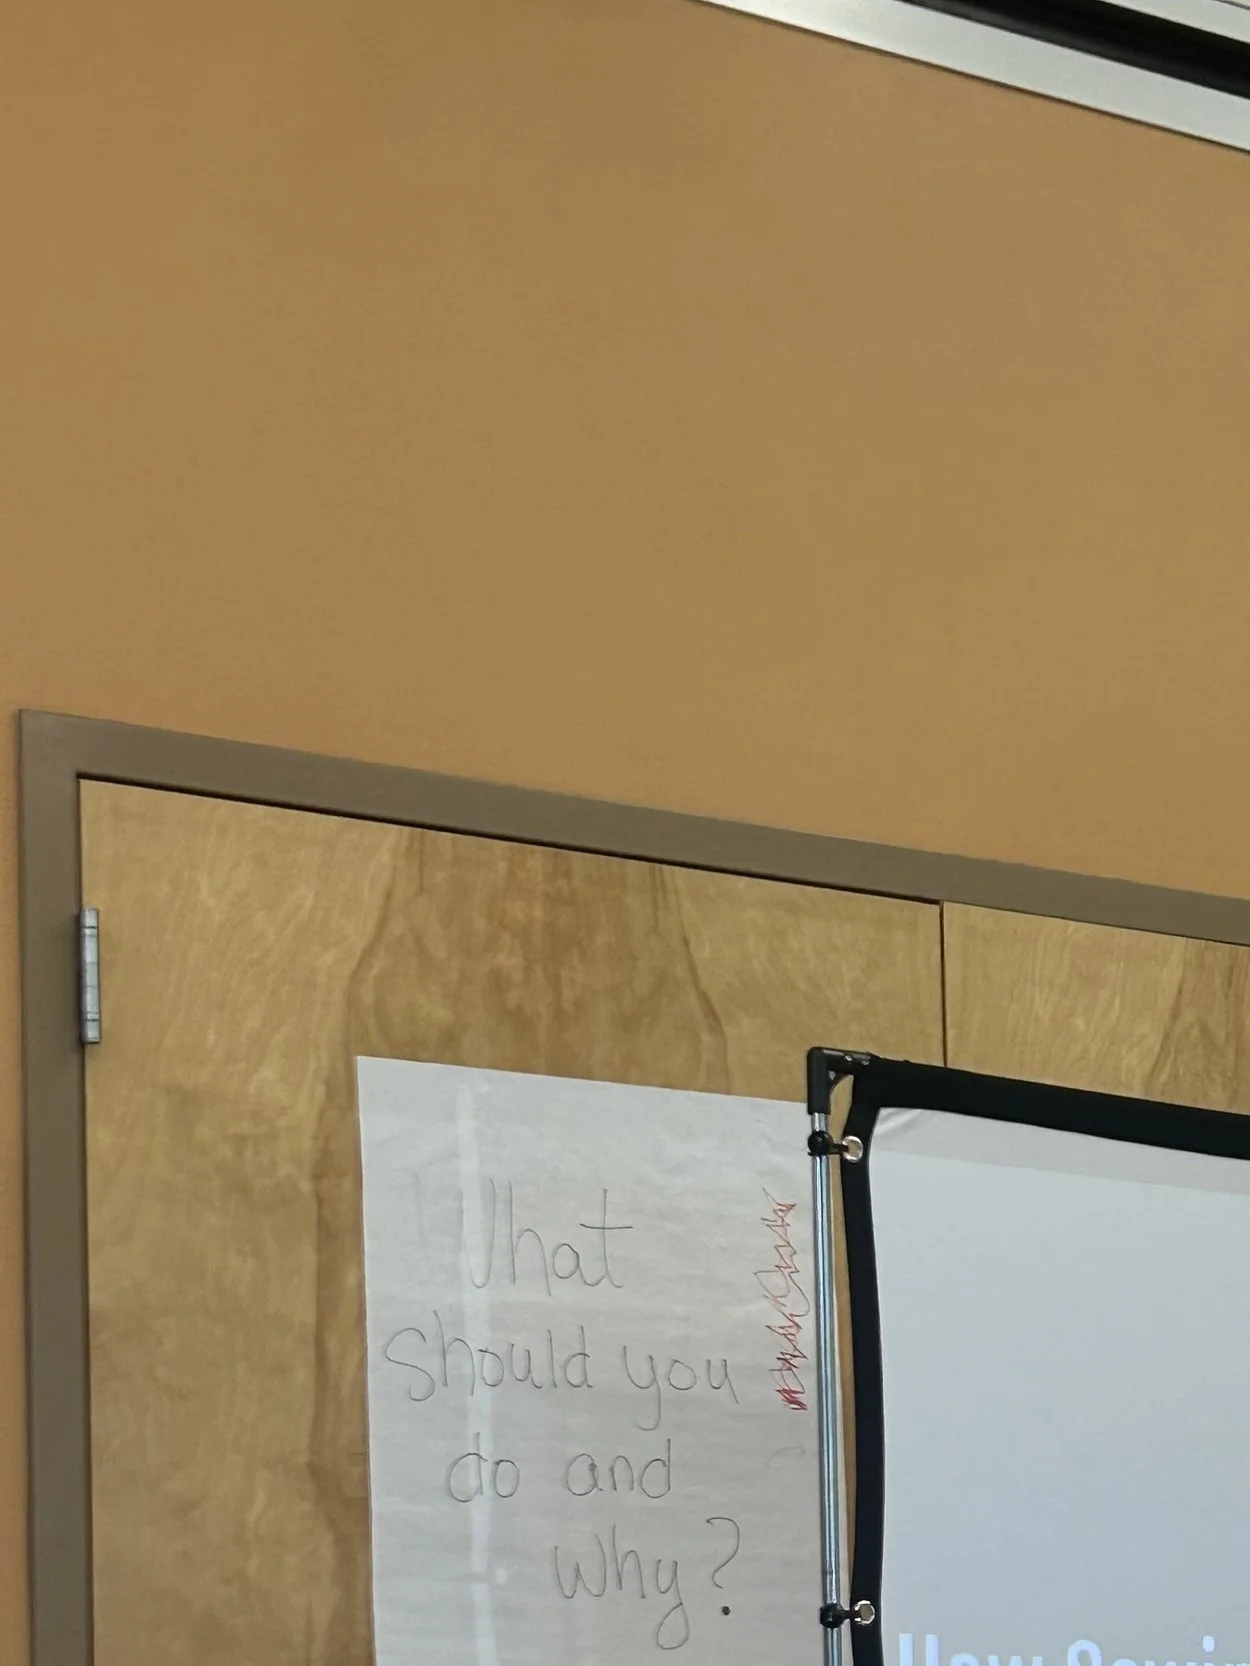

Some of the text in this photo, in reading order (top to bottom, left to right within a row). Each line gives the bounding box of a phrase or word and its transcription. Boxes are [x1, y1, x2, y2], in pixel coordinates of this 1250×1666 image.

[621, 1345, 740, 1431] you
[447, 1432, 672, 1502] do and
